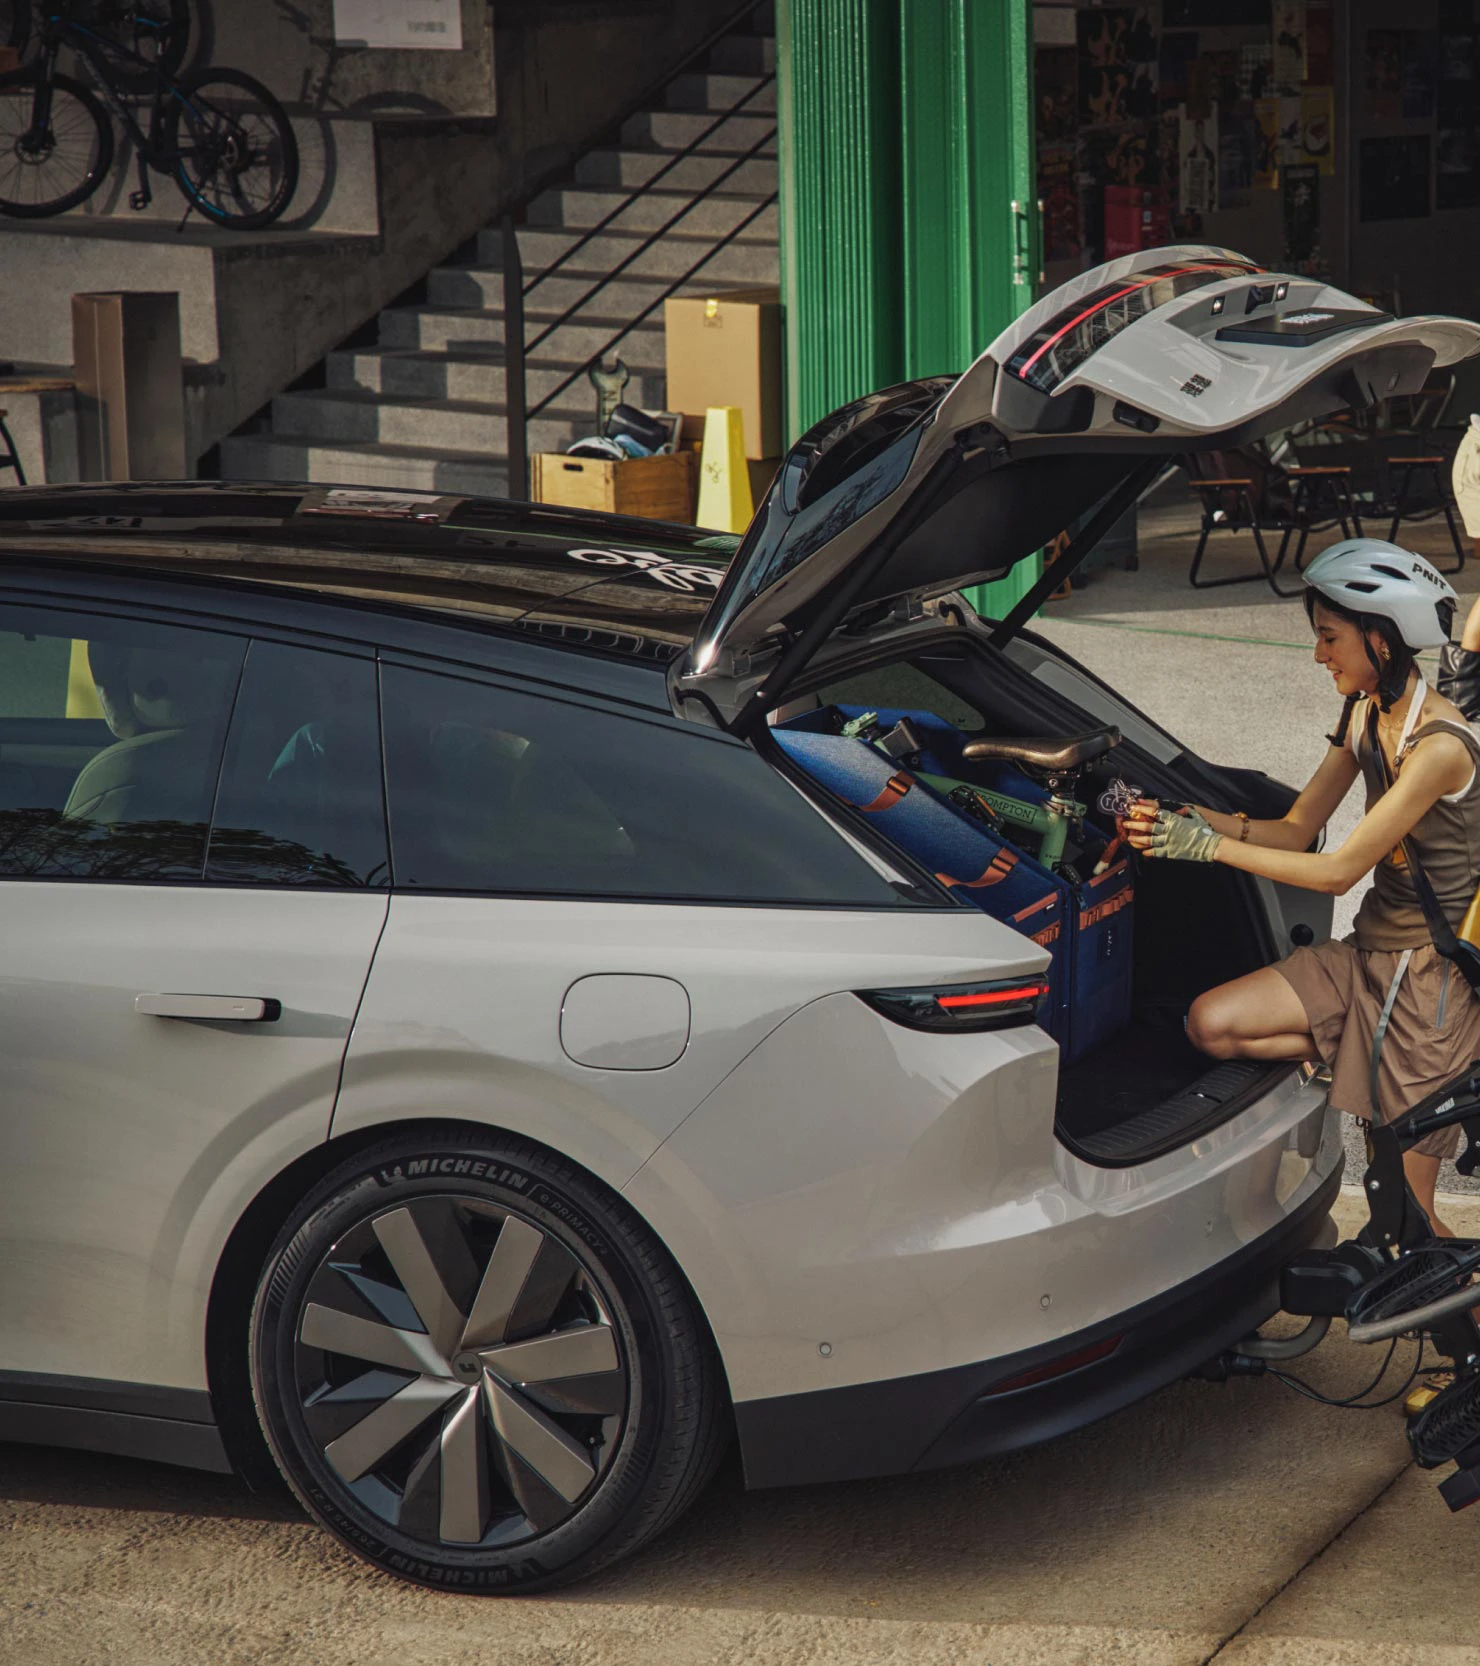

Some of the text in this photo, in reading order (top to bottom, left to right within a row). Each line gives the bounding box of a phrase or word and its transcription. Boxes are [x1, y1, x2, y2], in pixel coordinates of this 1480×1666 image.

[1412, 563, 1447, 590] PNIT
[984, 796, 1032, 819] OMPTON
[407, 1157, 528, 1190] MICHELIN
